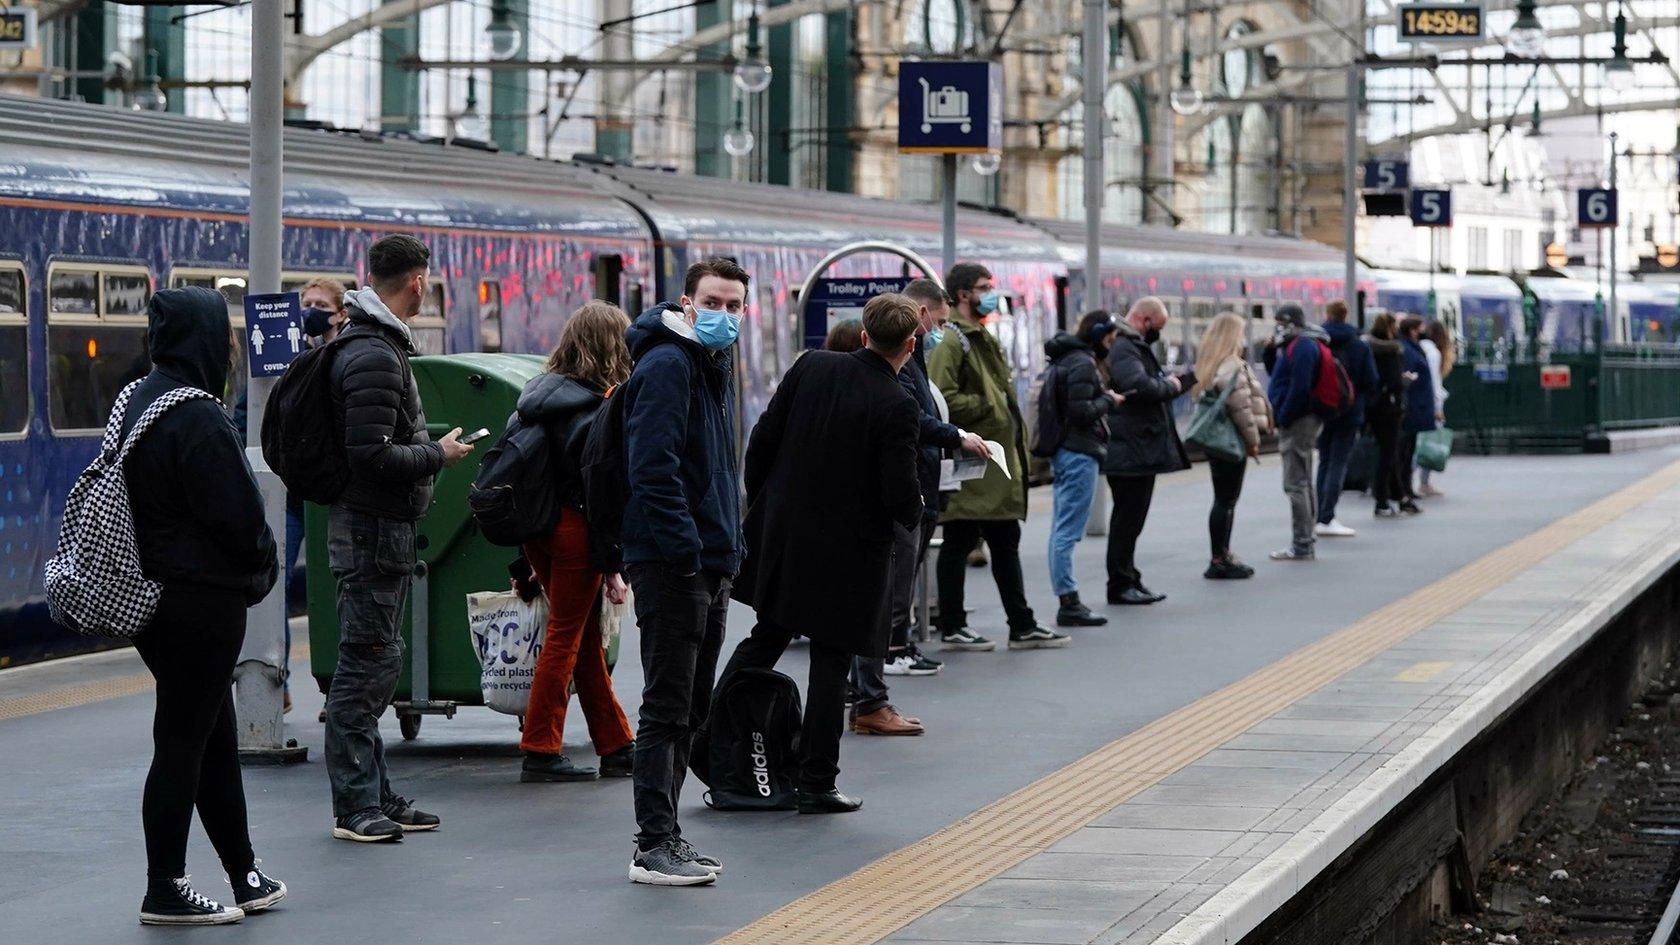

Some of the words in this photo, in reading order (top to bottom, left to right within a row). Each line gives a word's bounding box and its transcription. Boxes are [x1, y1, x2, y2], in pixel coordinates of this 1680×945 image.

[1377, 162, 1396, 190] 5
[1421, 192, 1441, 222] 5
[1587, 192, 1608, 222] 6
[827, 282, 866, 296] Trolley
[868, 282, 900, 294] Point
[274, 302, 290, 310] your
[259, 311, 288, 319] distance
[263, 363, 290, 371] COVID-1
[471, 613, 497, 623] Made
[498, 609, 518, 618] from
[508, 667, 537, 678] plast
[500, 681, 534, 692] recycla
[751, 732, 771, 797] adidas
